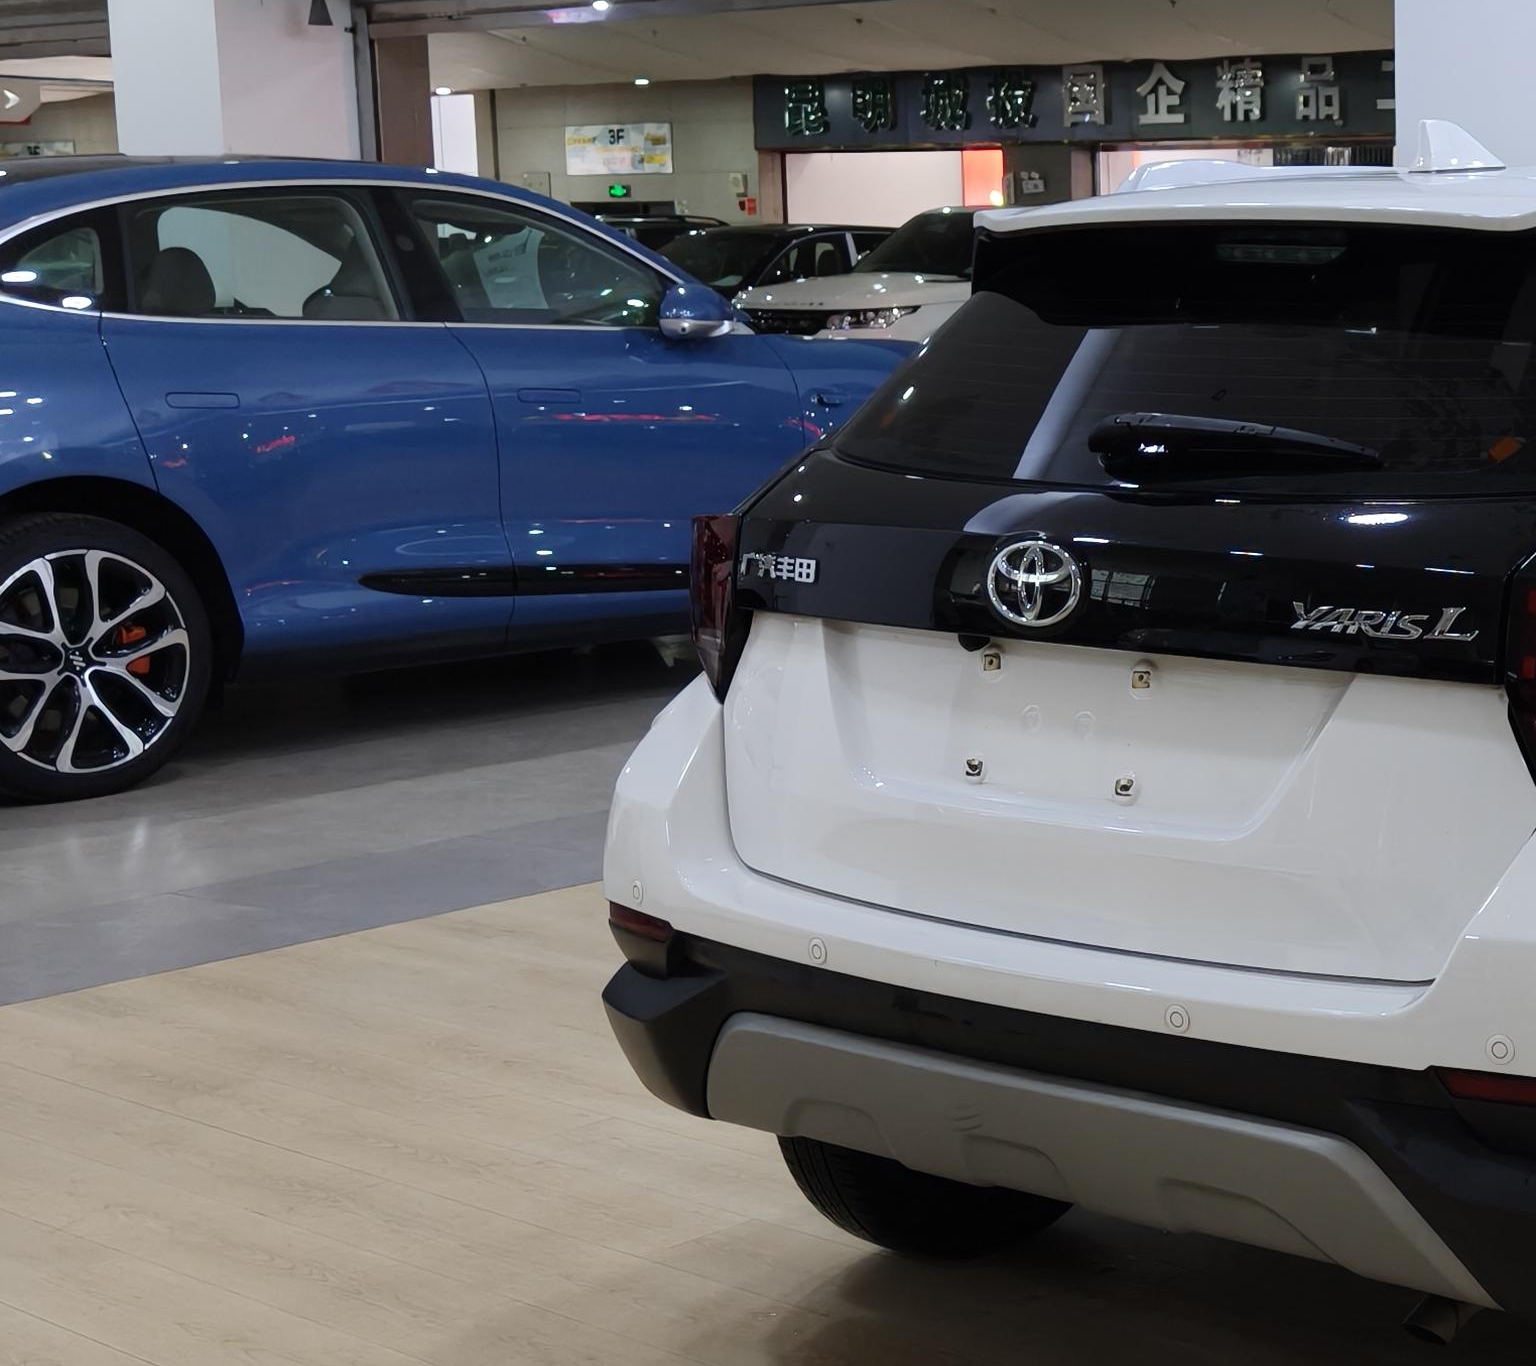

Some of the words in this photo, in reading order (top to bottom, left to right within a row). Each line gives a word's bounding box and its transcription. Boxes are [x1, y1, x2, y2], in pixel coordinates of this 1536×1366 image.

[608, 129, 624, 145] 3F
[740, 552, 816, 583] 广汽丰田
[1290, 601, 1430, 640] YARIS
[1422, 606, 1479, 641] L
